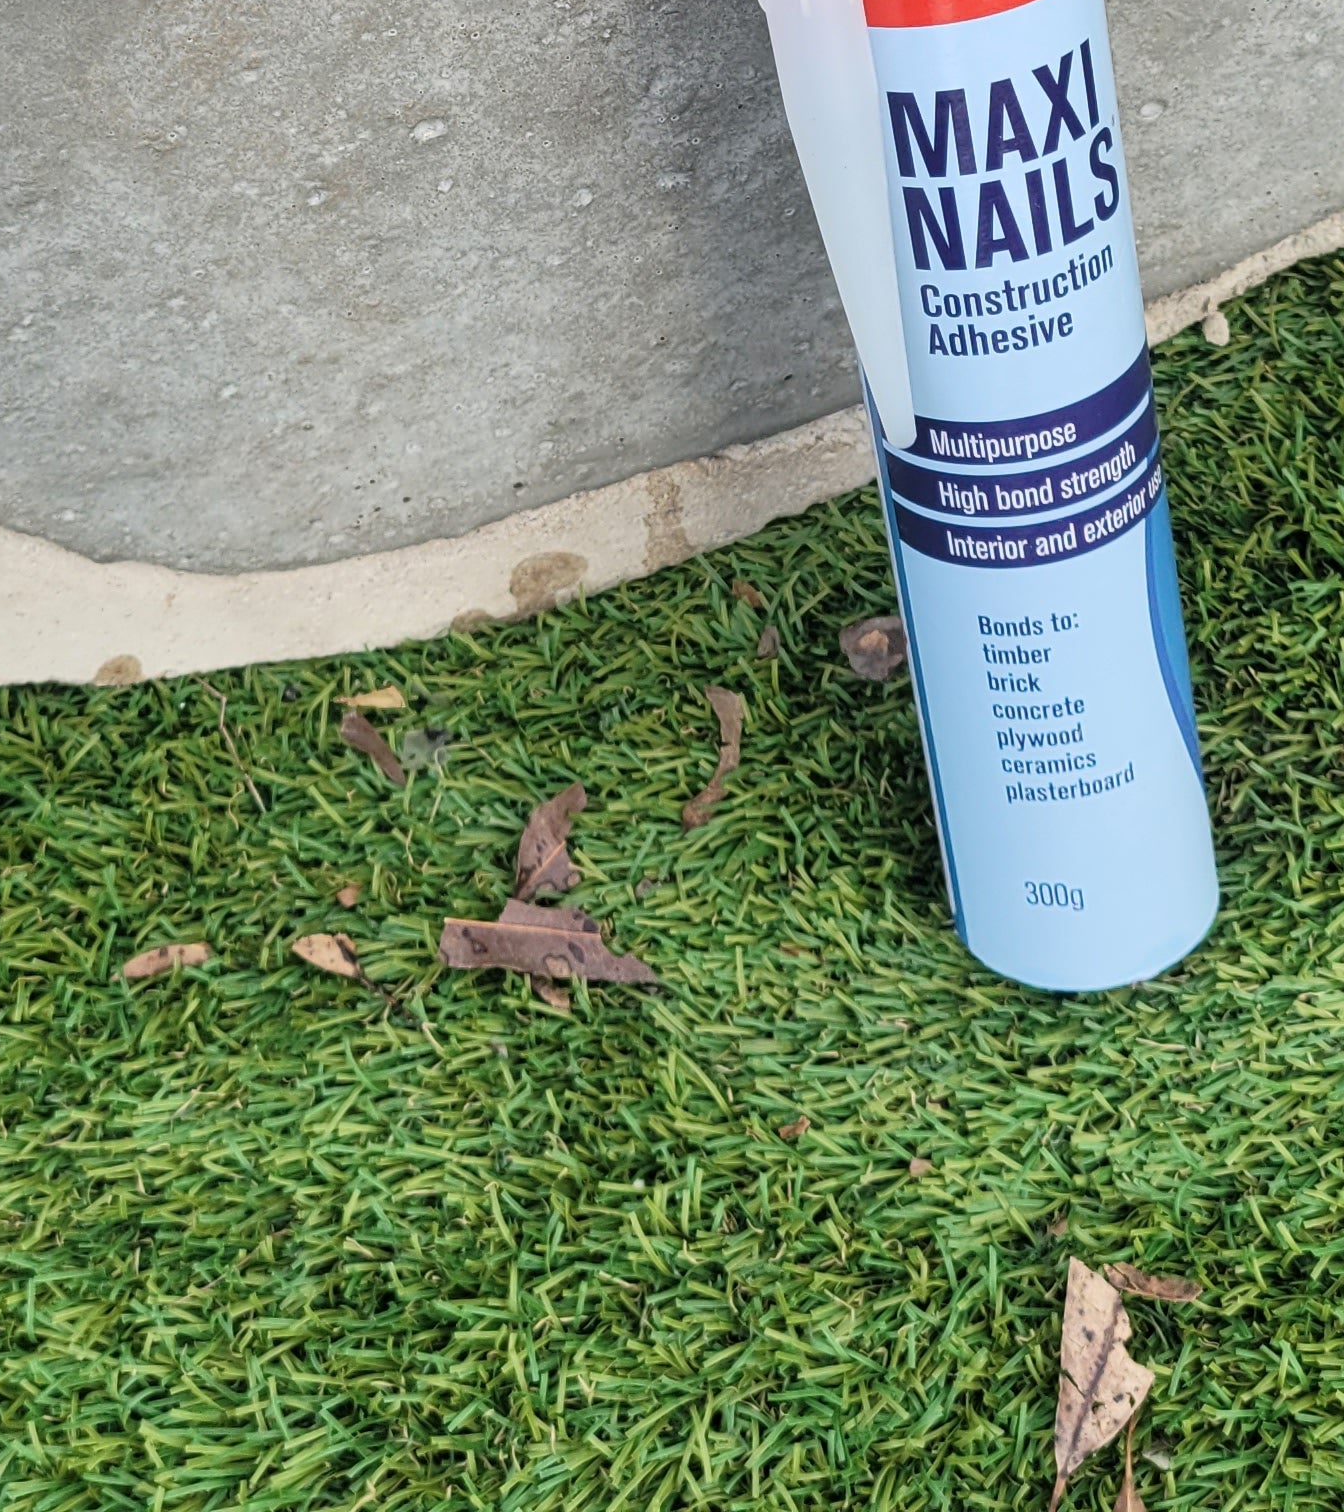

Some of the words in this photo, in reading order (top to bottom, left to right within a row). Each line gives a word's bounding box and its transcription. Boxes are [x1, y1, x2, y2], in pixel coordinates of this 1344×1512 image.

[886, 38, 1099, 178] MAXI
[902, 127, 1120, 271] NAILS
[920, 244, 1114, 318] Construction
[929, 312, 1074, 356] Adhesive
[929, 422, 1077, 463] Multipurpose
[938, 480, 990, 516] High
[995, 477, 1054, 511] bond
[1060, 440, 1136, 500] strength
[946, 530, 1028, 560] Interior
[1035, 522, 1077, 557] and
[1083, 487, 1146, 543] exterior
[1147, 463, 1162, 499] use
[978, 615, 1044, 637] Bonds
[1051, 612, 1080, 632] to:
[983, 643, 1051, 665] timber
[987, 671, 1042, 693] brick
[992, 696, 1085, 721] concrete
[997, 722, 1084, 752] plywood
[1001, 752, 1097, 775] ceramics
[1006, 761, 1135, 804] plasterboard
[1024, 881, 1085, 911] 300g
